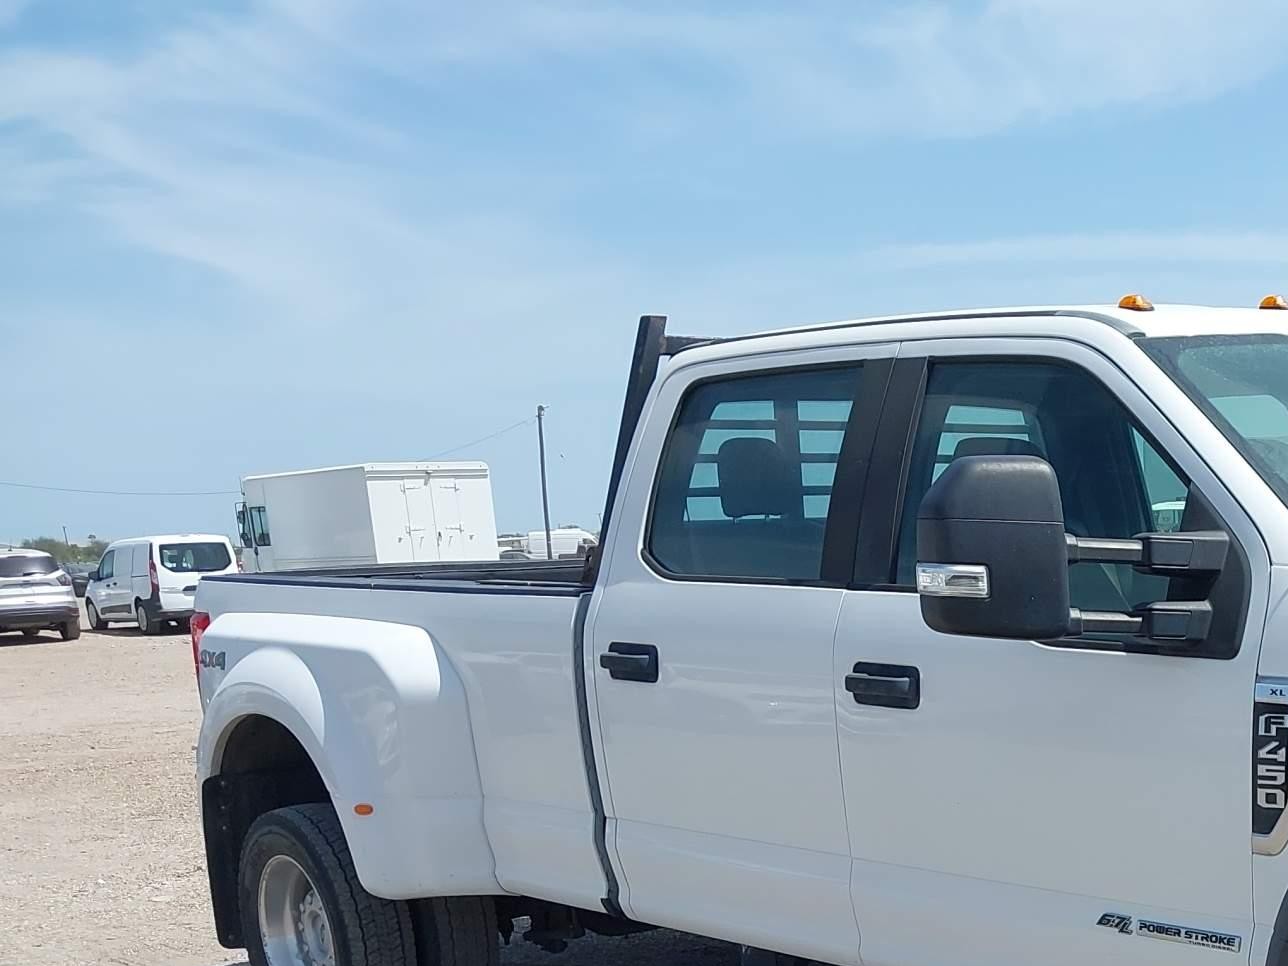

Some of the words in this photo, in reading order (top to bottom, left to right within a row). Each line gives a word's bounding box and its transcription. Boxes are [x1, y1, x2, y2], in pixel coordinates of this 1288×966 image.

[1269, 688, 1287, 697] XL
[1138, 921, 1182, 938] POWER
[1183, 929, 1237, 947] STROKE
